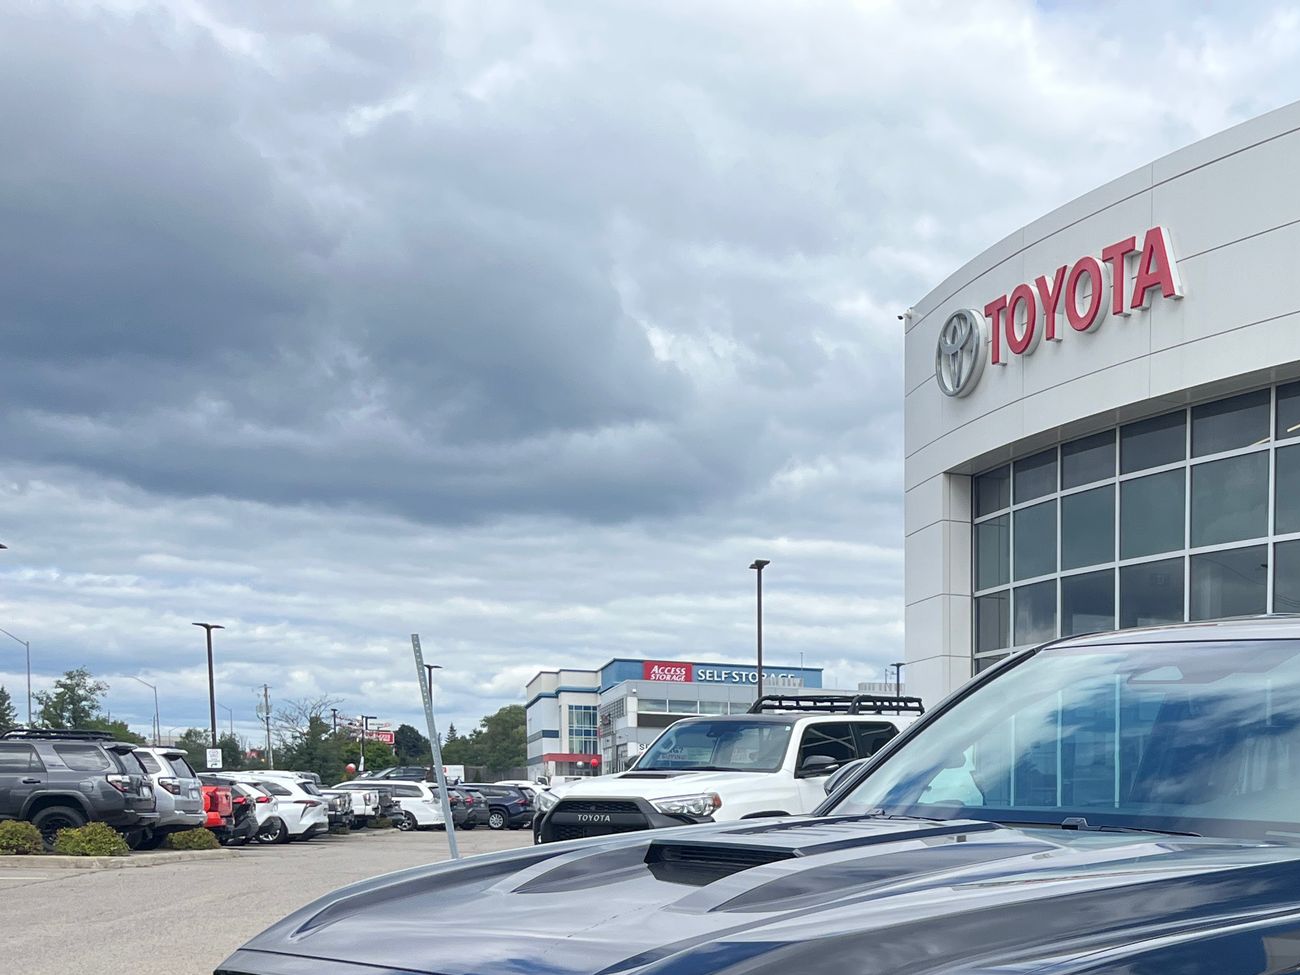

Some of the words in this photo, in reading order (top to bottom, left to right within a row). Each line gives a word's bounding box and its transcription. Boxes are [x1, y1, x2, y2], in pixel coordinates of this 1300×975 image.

[984, 226, 1182, 366] TOYOTA
[650, 665, 686, 675] ACCESS
[698, 669, 731, 681] SELF
[650, 673, 686, 681] STORAGE
[577, 814, 611, 822] TOYOTA
